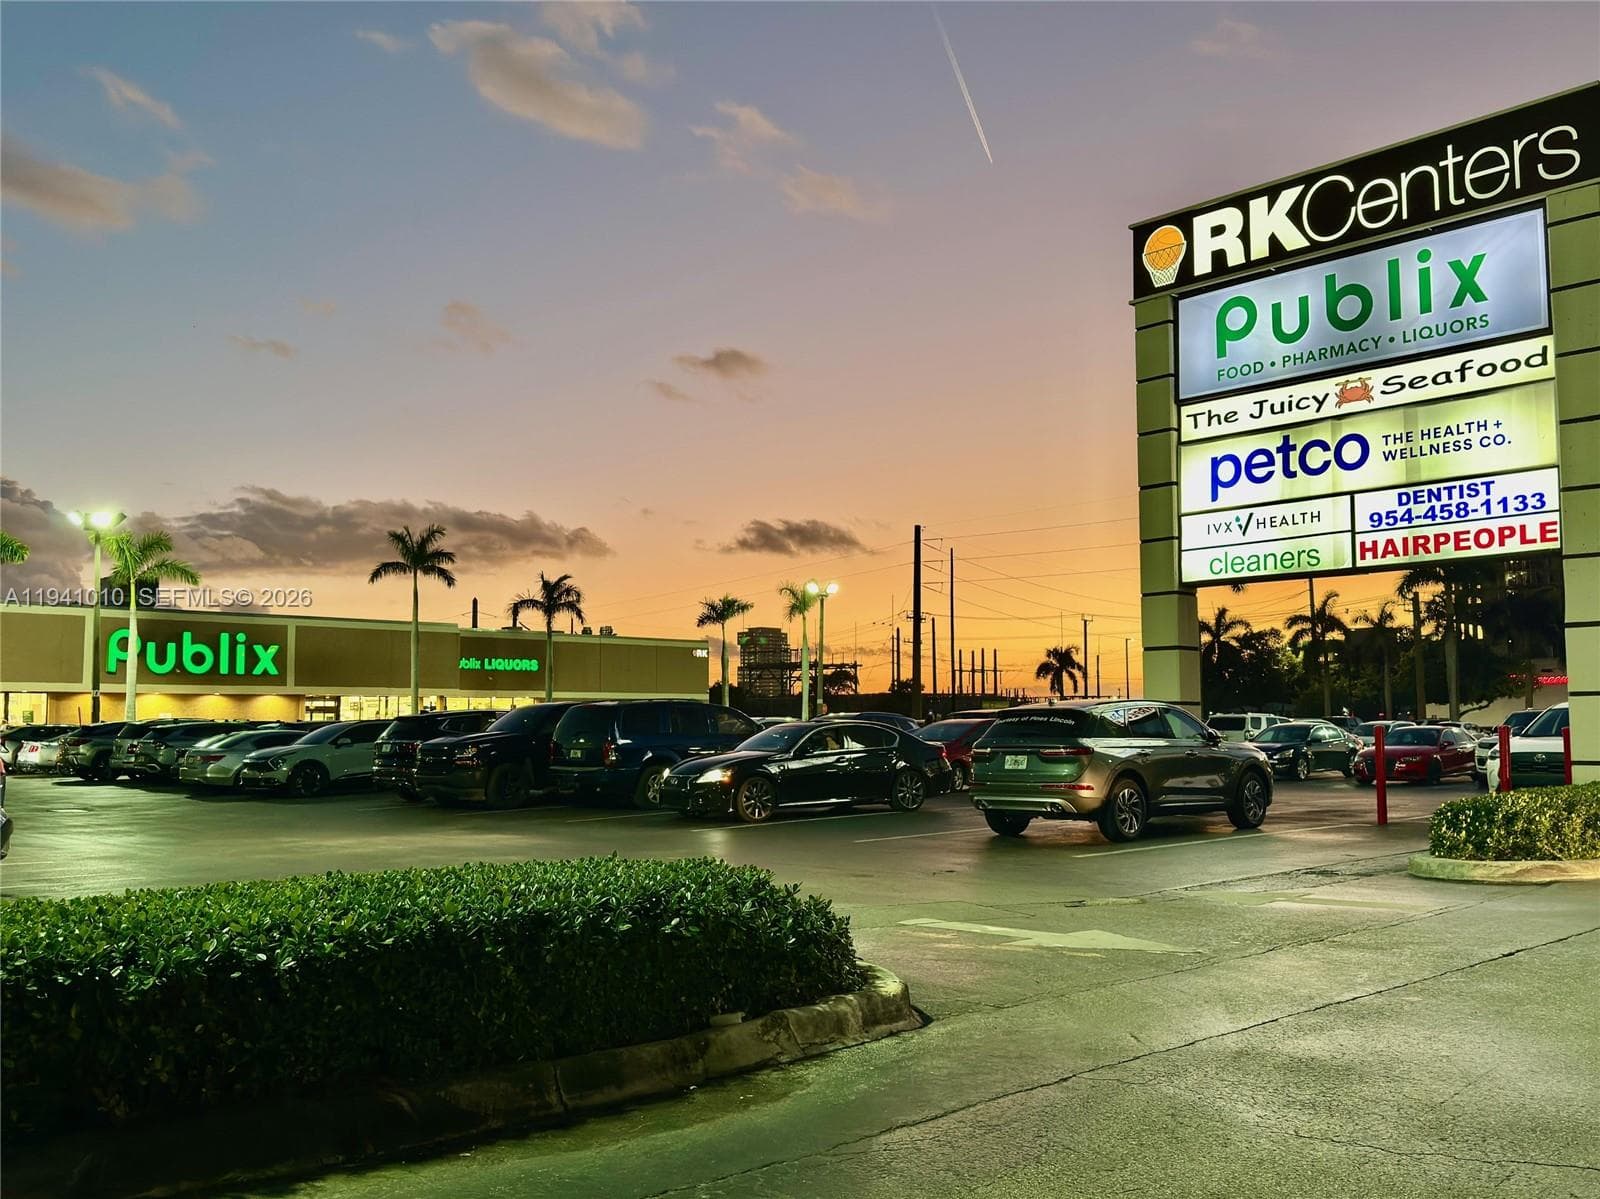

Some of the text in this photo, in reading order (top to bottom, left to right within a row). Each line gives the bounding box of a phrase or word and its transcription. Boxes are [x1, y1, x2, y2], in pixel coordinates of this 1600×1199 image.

[1215, 248, 1489, 359] Publix
[1217, 313, 1490, 382] FOOD PHARMACY LIQUORS
[1186, 345, 1549, 430] The Juicy Seafood
[1382, 431, 1414, 446] THE
[1420, 419, 1488, 441] HEALTH
[1382, 433, 1512, 462] WELLNESS CO.
[1210, 433, 1370, 502] petco
[1369, 492, 1547, 529] 954-458-1133
[1397, 480, 1495, 507] DENTIST
[1207, 510, 1321, 536] IVX HEALTH
[1359, 520, 1559, 561] HAIRPEOPLE
[1209, 547, 1321, 575] cleaners
[106, 628, 280, 676] Publix
[459, 657, 539, 671] blix LIQUORS
